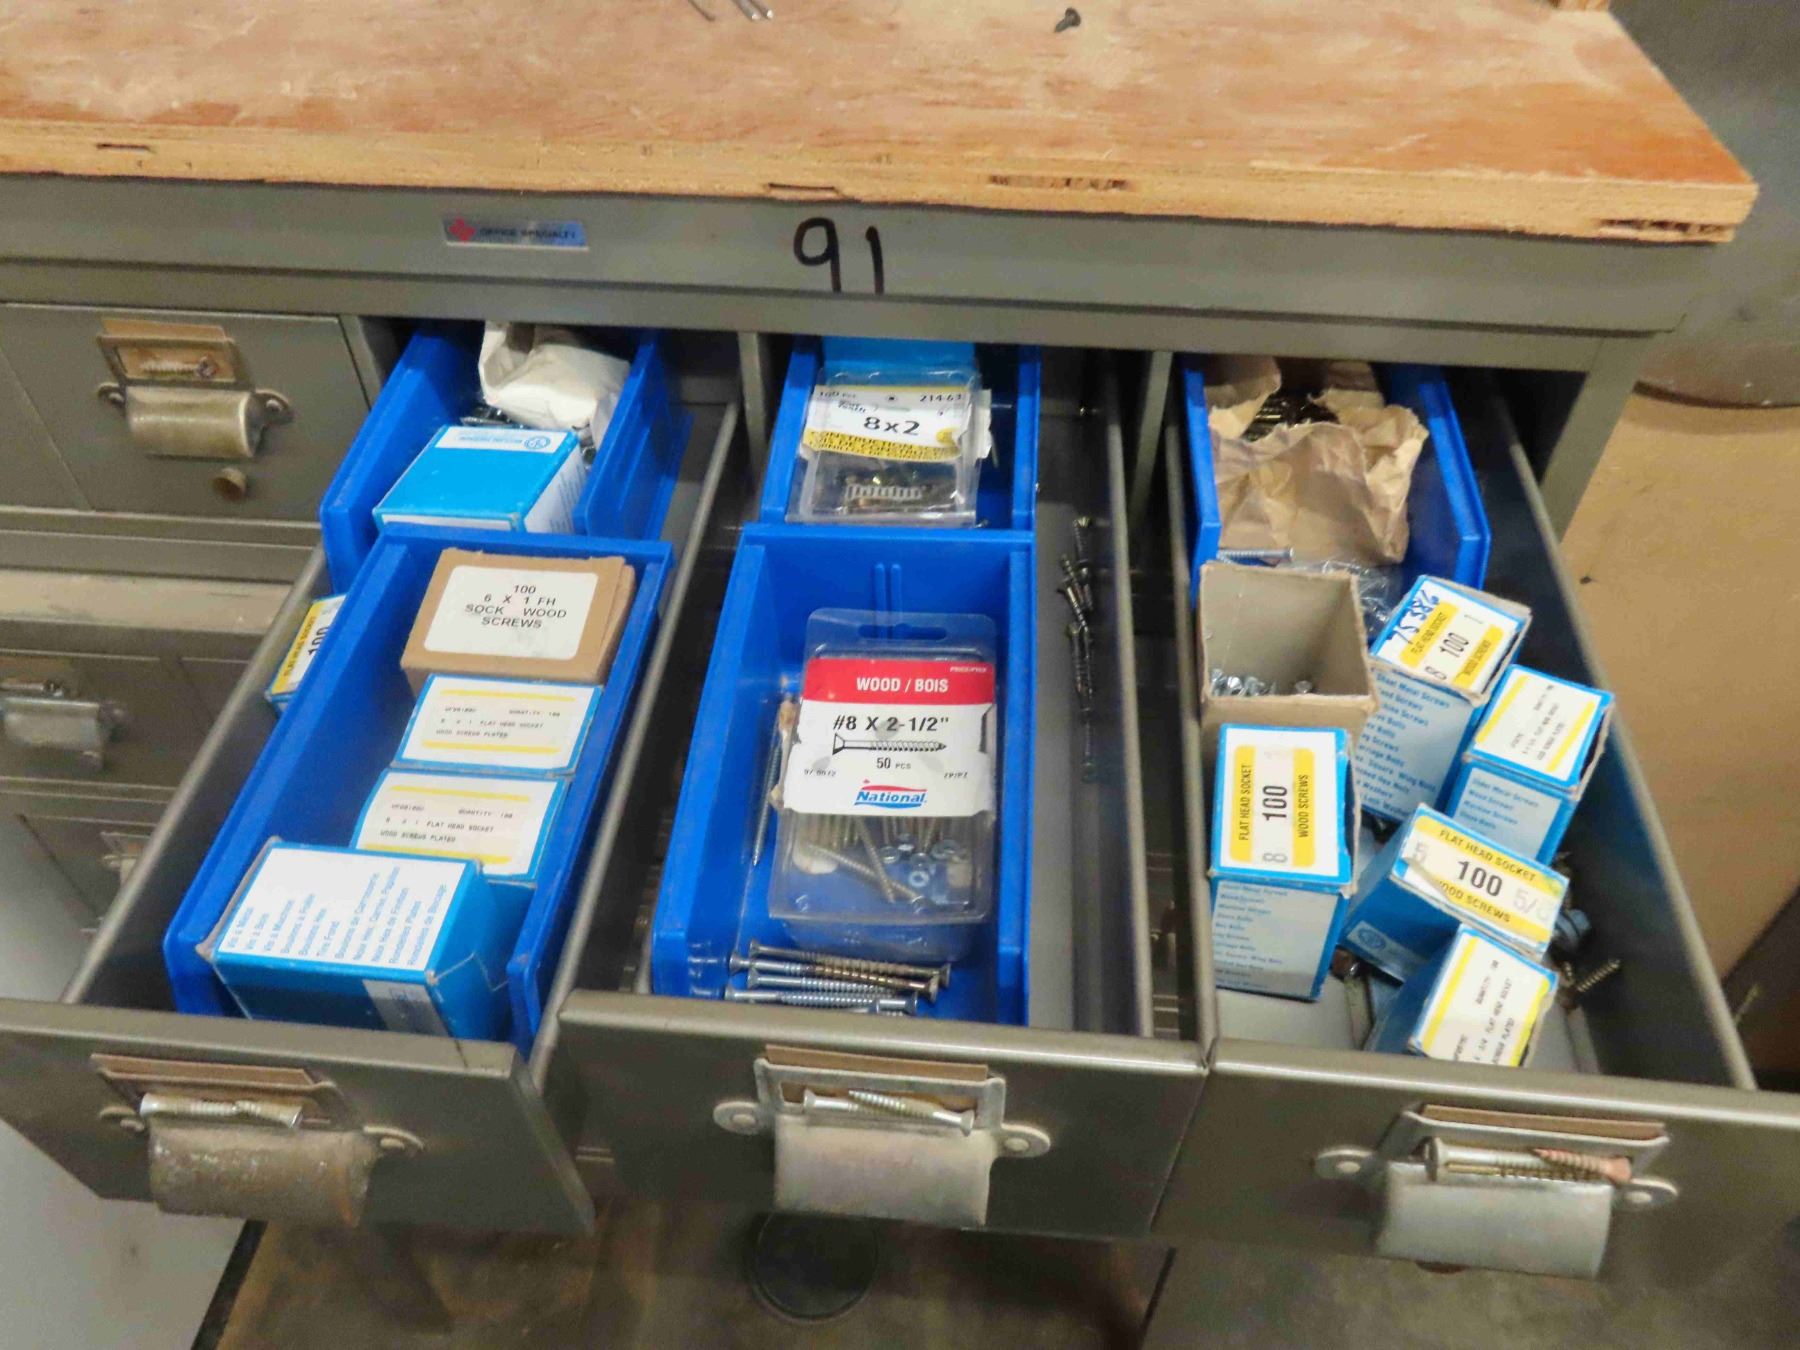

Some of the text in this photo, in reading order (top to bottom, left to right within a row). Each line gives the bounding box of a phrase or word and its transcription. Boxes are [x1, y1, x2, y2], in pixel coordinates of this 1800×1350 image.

[793, 216, 885, 296] 91
[513, 584, 537, 594] 100
[537, 596, 556, 606] FH
[464, 603, 567, 618] SOCK WOOD
[481, 616, 542, 629] SCREWS
[1439, 632, 1469, 658] 100
[856, 677, 900, 693] WOOD
[914, 678, 949, 693] BOIS
[1394, 695, 1424, 710] Screws
[1420, 693, 1451, 707] Screws
[832, 714, 857, 731] #8
[865, 716, 879, 731] X
[1399, 710, 1430, 725] Screws
[876, 757, 891, 770] 50
[856, 790, 926, 803] National
[1238, 764, 1251, 841] FLAT HEAD SOCKET
[1298, 774, 1309, 838] WOOD SCREWS
[1262, 785, 1288, 864] 8 100
[1440, 829, 1537, 882] FLAT HEAD SOCKET
[1457, 860, 1503, 897] 100
[1466, 895, 1511, 923] SCREWS
